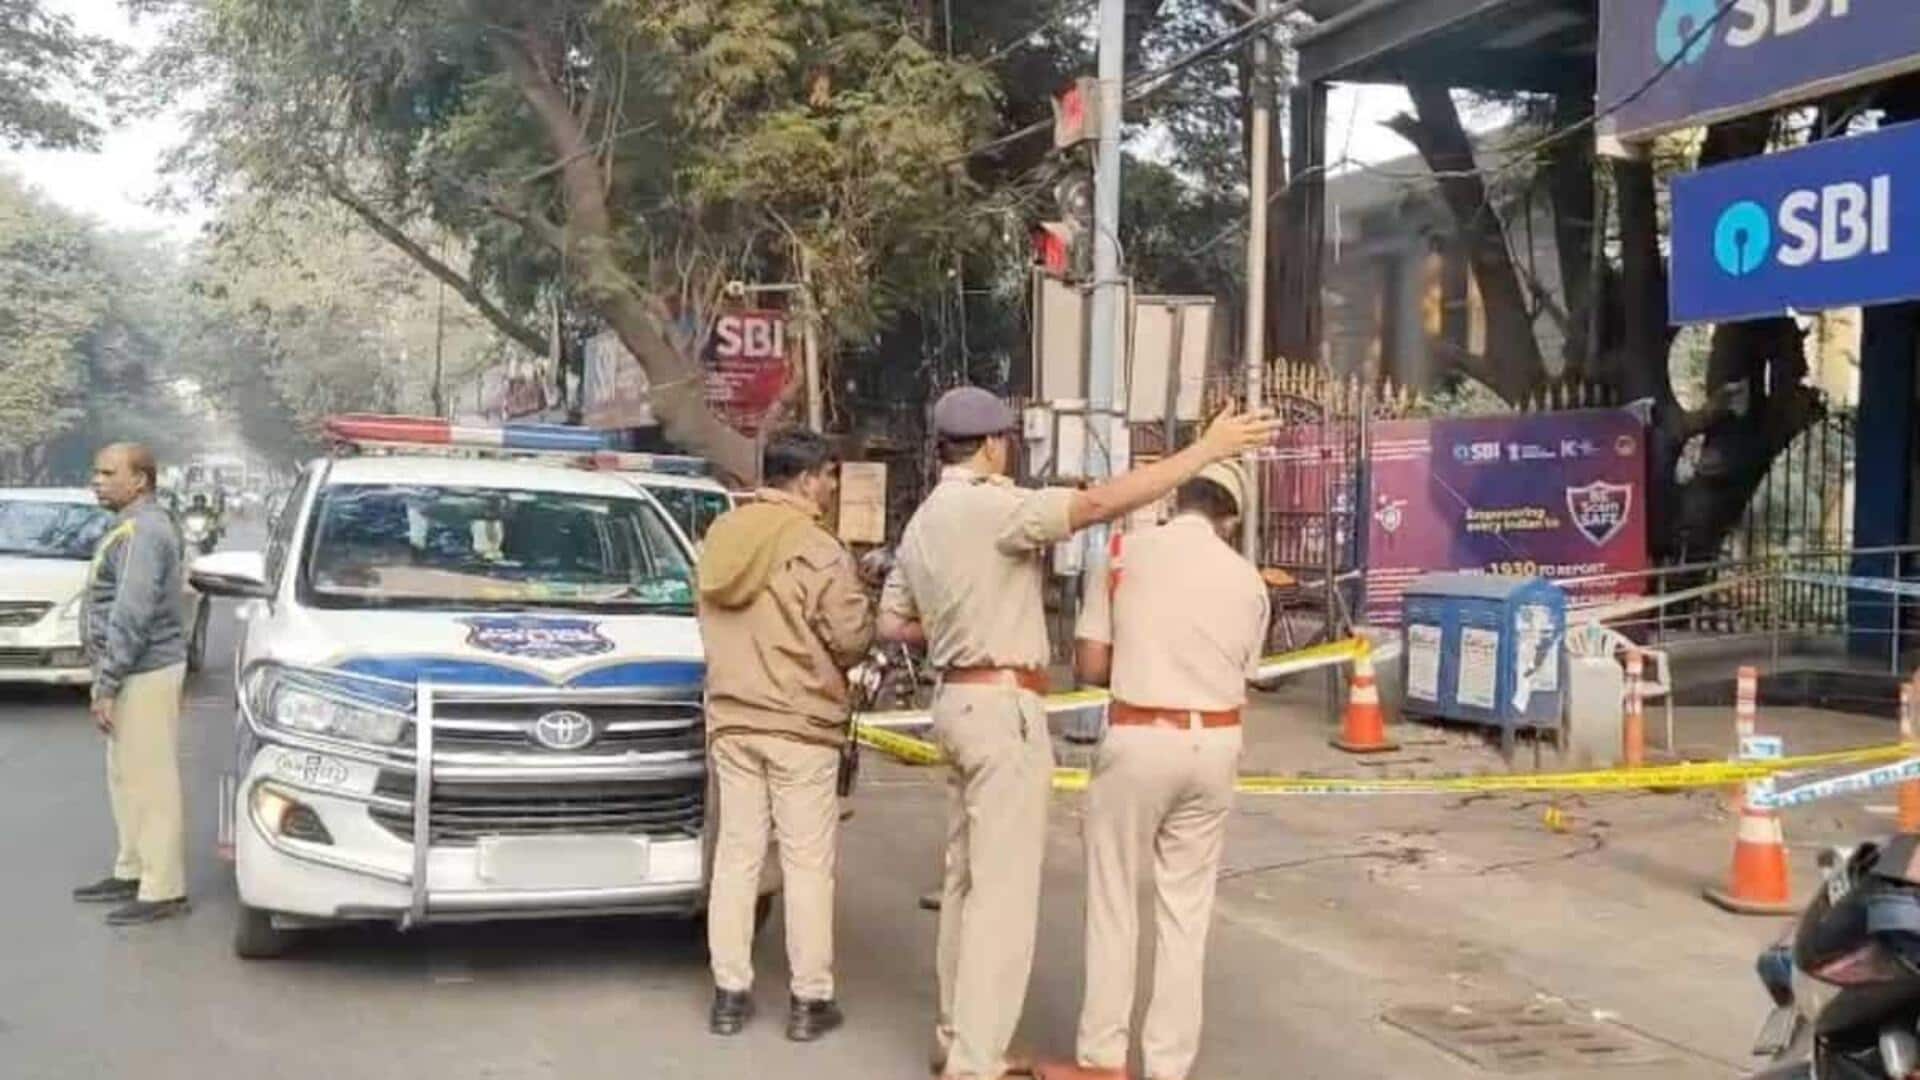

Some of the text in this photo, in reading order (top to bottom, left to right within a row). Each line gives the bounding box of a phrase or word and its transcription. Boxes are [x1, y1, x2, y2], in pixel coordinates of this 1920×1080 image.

[1776, 174, 1891, 267] SBI
[716, 316, 782, 357] SBI
[1471, 441, 1500, 461] SBI
[1489, 560, 1536, 577] 1930
